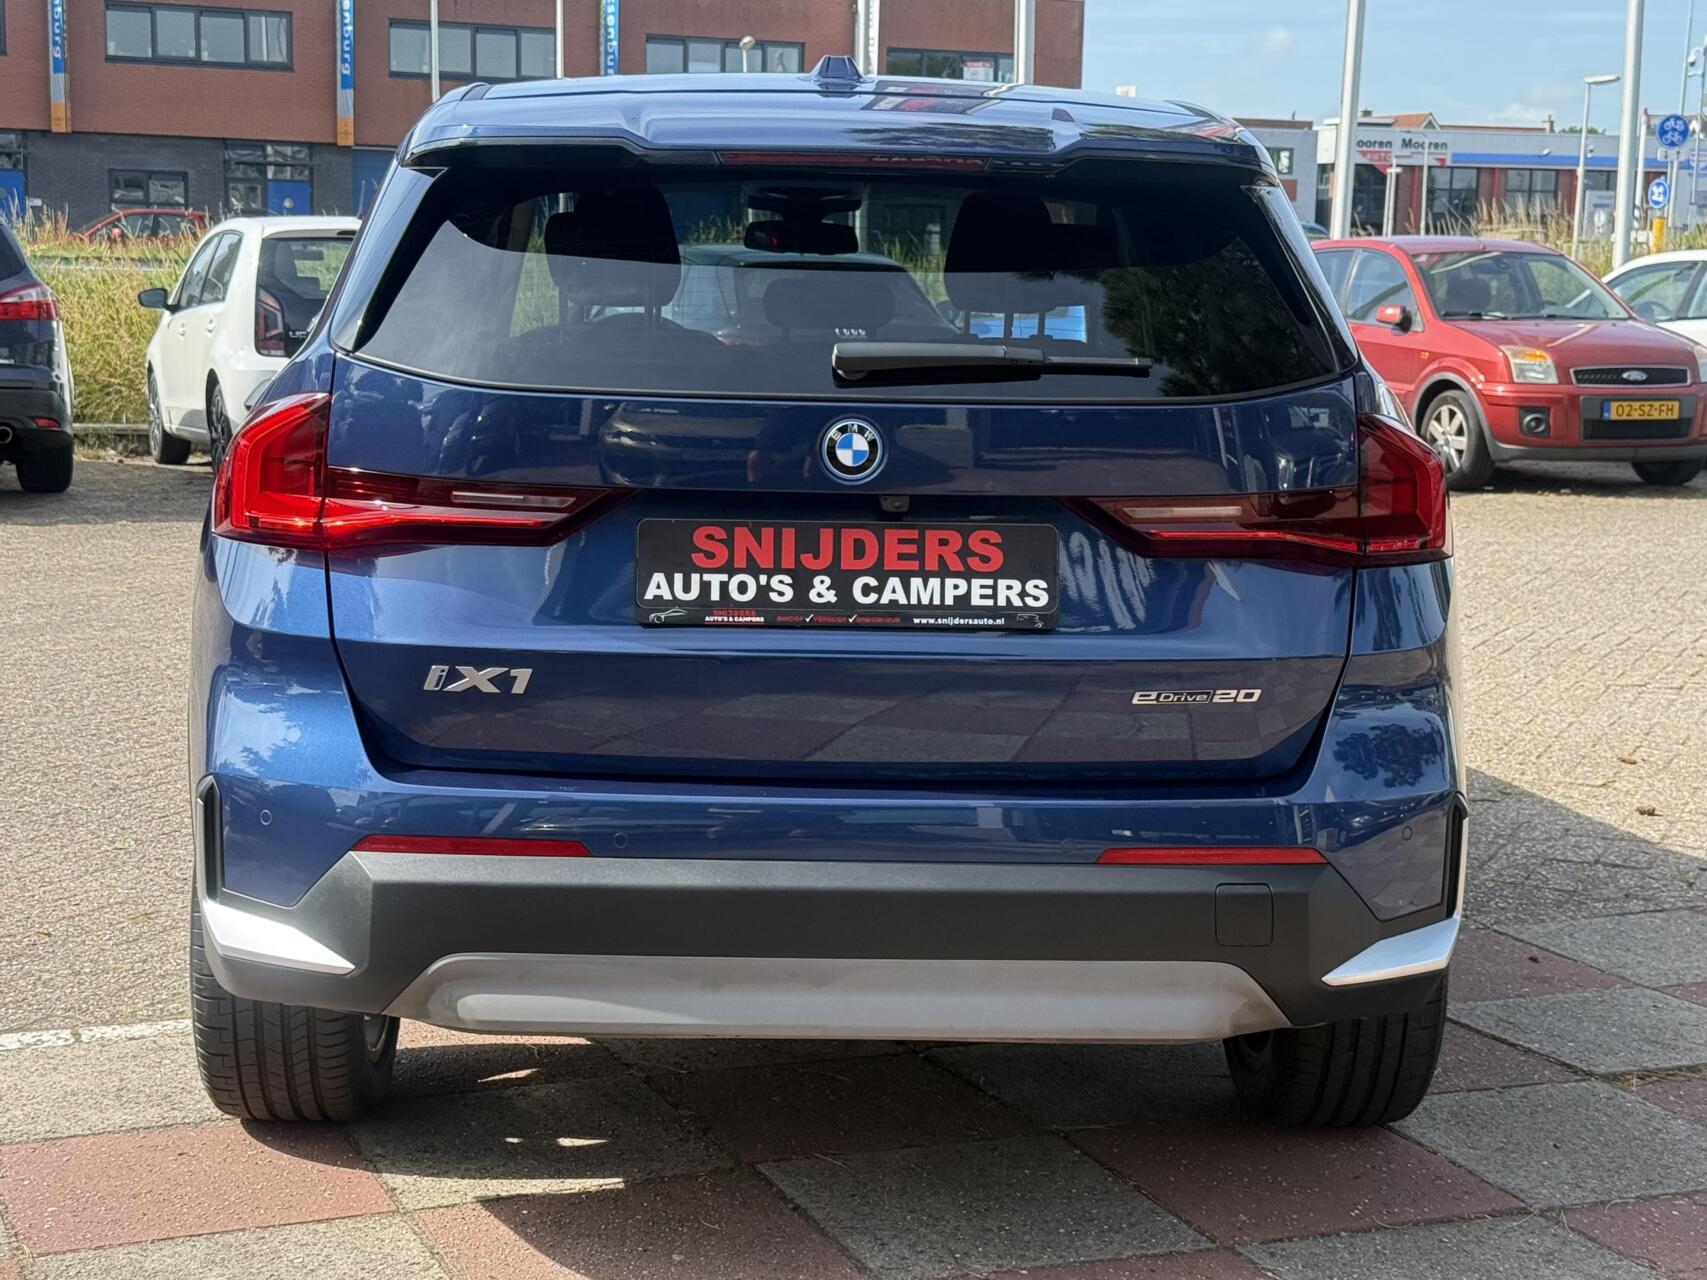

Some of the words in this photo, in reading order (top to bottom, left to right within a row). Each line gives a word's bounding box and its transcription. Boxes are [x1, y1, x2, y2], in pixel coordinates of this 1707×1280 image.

[1356, 139, 1392, 148] ooren
[830, 424, 875, 441] BMW
[691, 525, 1004, 572] SNIJDERS
[643, 572, 794, 603] AUTO'S
[808, 575, 838, 604] &
[852, 576, 1050, 608] CAMPERS
[913, 616, 1005, 626] www.snijdersauto.nl
[423, 665, 533, 694] iX1
